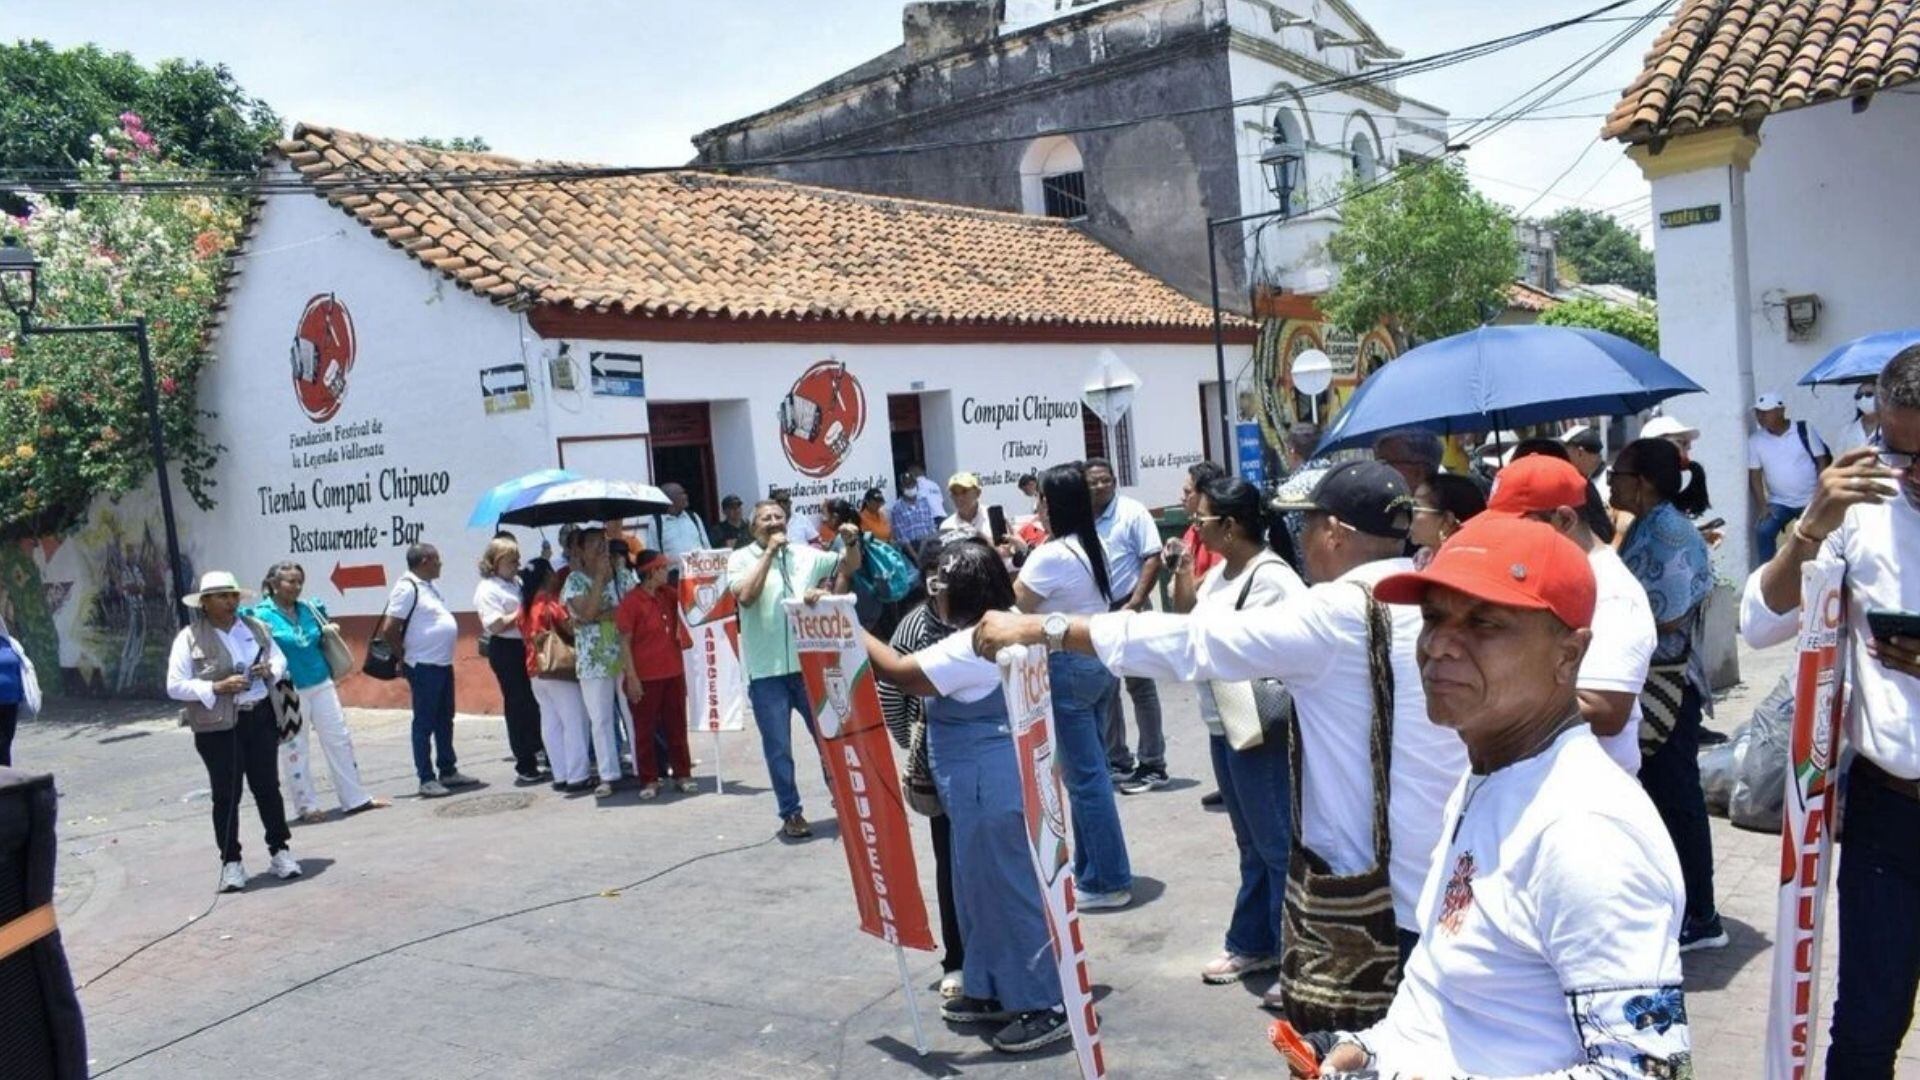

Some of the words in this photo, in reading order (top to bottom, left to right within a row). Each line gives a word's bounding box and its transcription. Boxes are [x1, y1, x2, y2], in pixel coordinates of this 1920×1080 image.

[962, 397, 1020, 430] Compai
[1023, 395, 1078, 427] Chipuco
[289, 427, 333, 450] Fundación
[334, 420, 370, 441] Festival
[371, 418, 383, 434] de
[292, 452, 301, 468] la
[303, 448, 340, 470] Leyenda
[341, 442, 385, 461] Vallenata
[1002, 440, 1048, 461] (Tibaré)
[1157, 453, 1166, 467] de
[258, 483, 307, 515] Tienda
[312, 473, 372, 513] Compai
[379, 467, 450, 507] Chipuco
[831, 476, 874, 494] Festival
[875, 475, 888, 489] de
[289, 523, 378, 553] Restaurante
[391, 516, 425, 546] Bar
[843, 745, 899, 945] ADUCESAR
